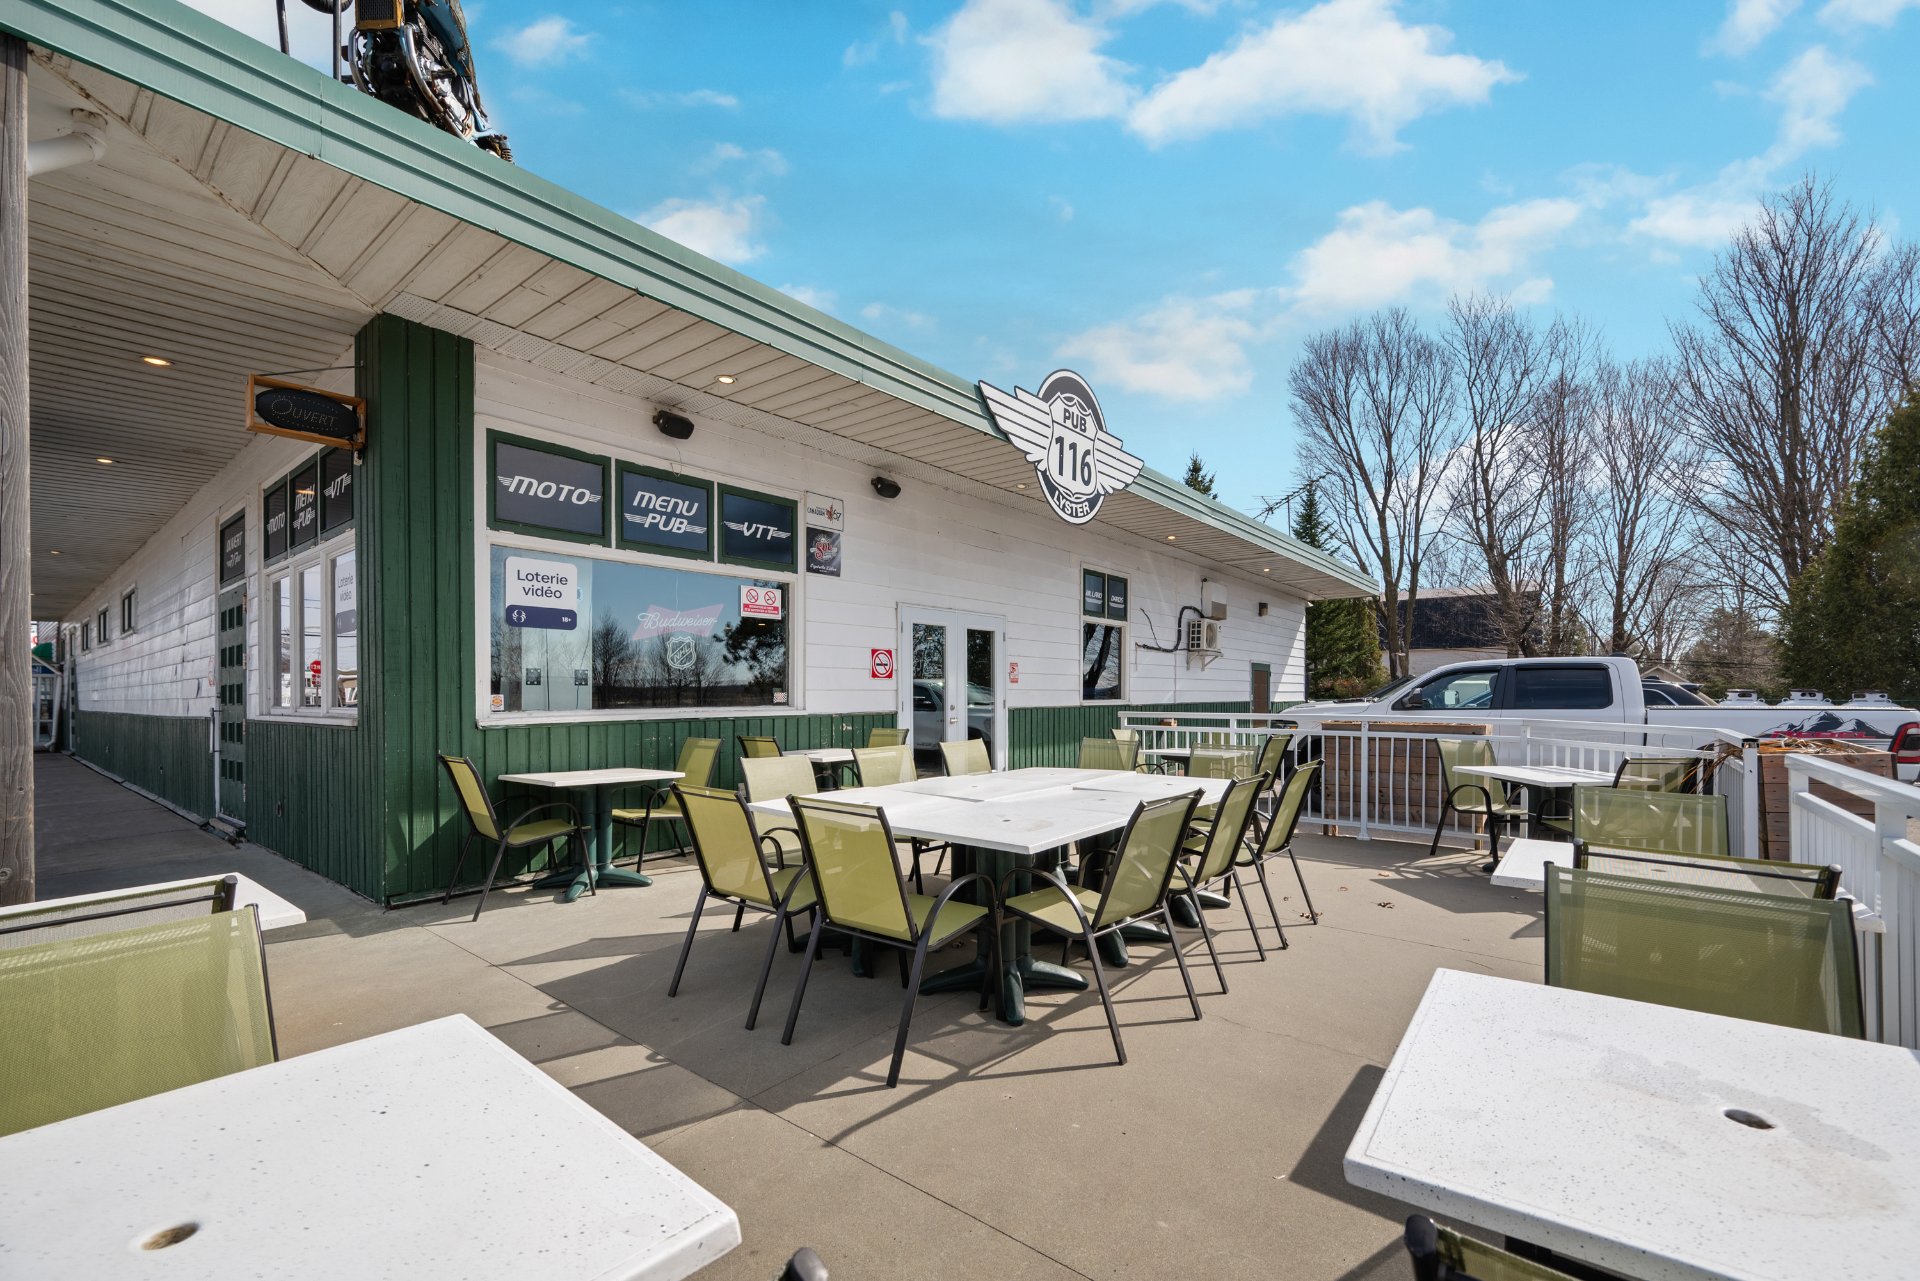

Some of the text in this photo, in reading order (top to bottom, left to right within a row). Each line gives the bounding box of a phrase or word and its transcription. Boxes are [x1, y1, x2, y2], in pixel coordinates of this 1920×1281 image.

[1063, 407, 1087, 434] PUB
[1055, 435, 1092, 487] 116
[331, 472, 348, 499] VTT
[507, 475, 591, 505] MOTO
[632, 490, 699, 517] MENU
[1053, 489, 1091, 517] LYSTER
[268, 511, 286, 535] MOTO
[297, 506, 312, 530] PUB
[644, 512, 688, 534] PUB
[742, 521, 779, 541] VTT
[517, 569, 569, 586] Loterie
[522, 584, 563, 599] vidéo
[637, 610, 718, 630] Budweiser
[673, 645, 691, 663] NHL
